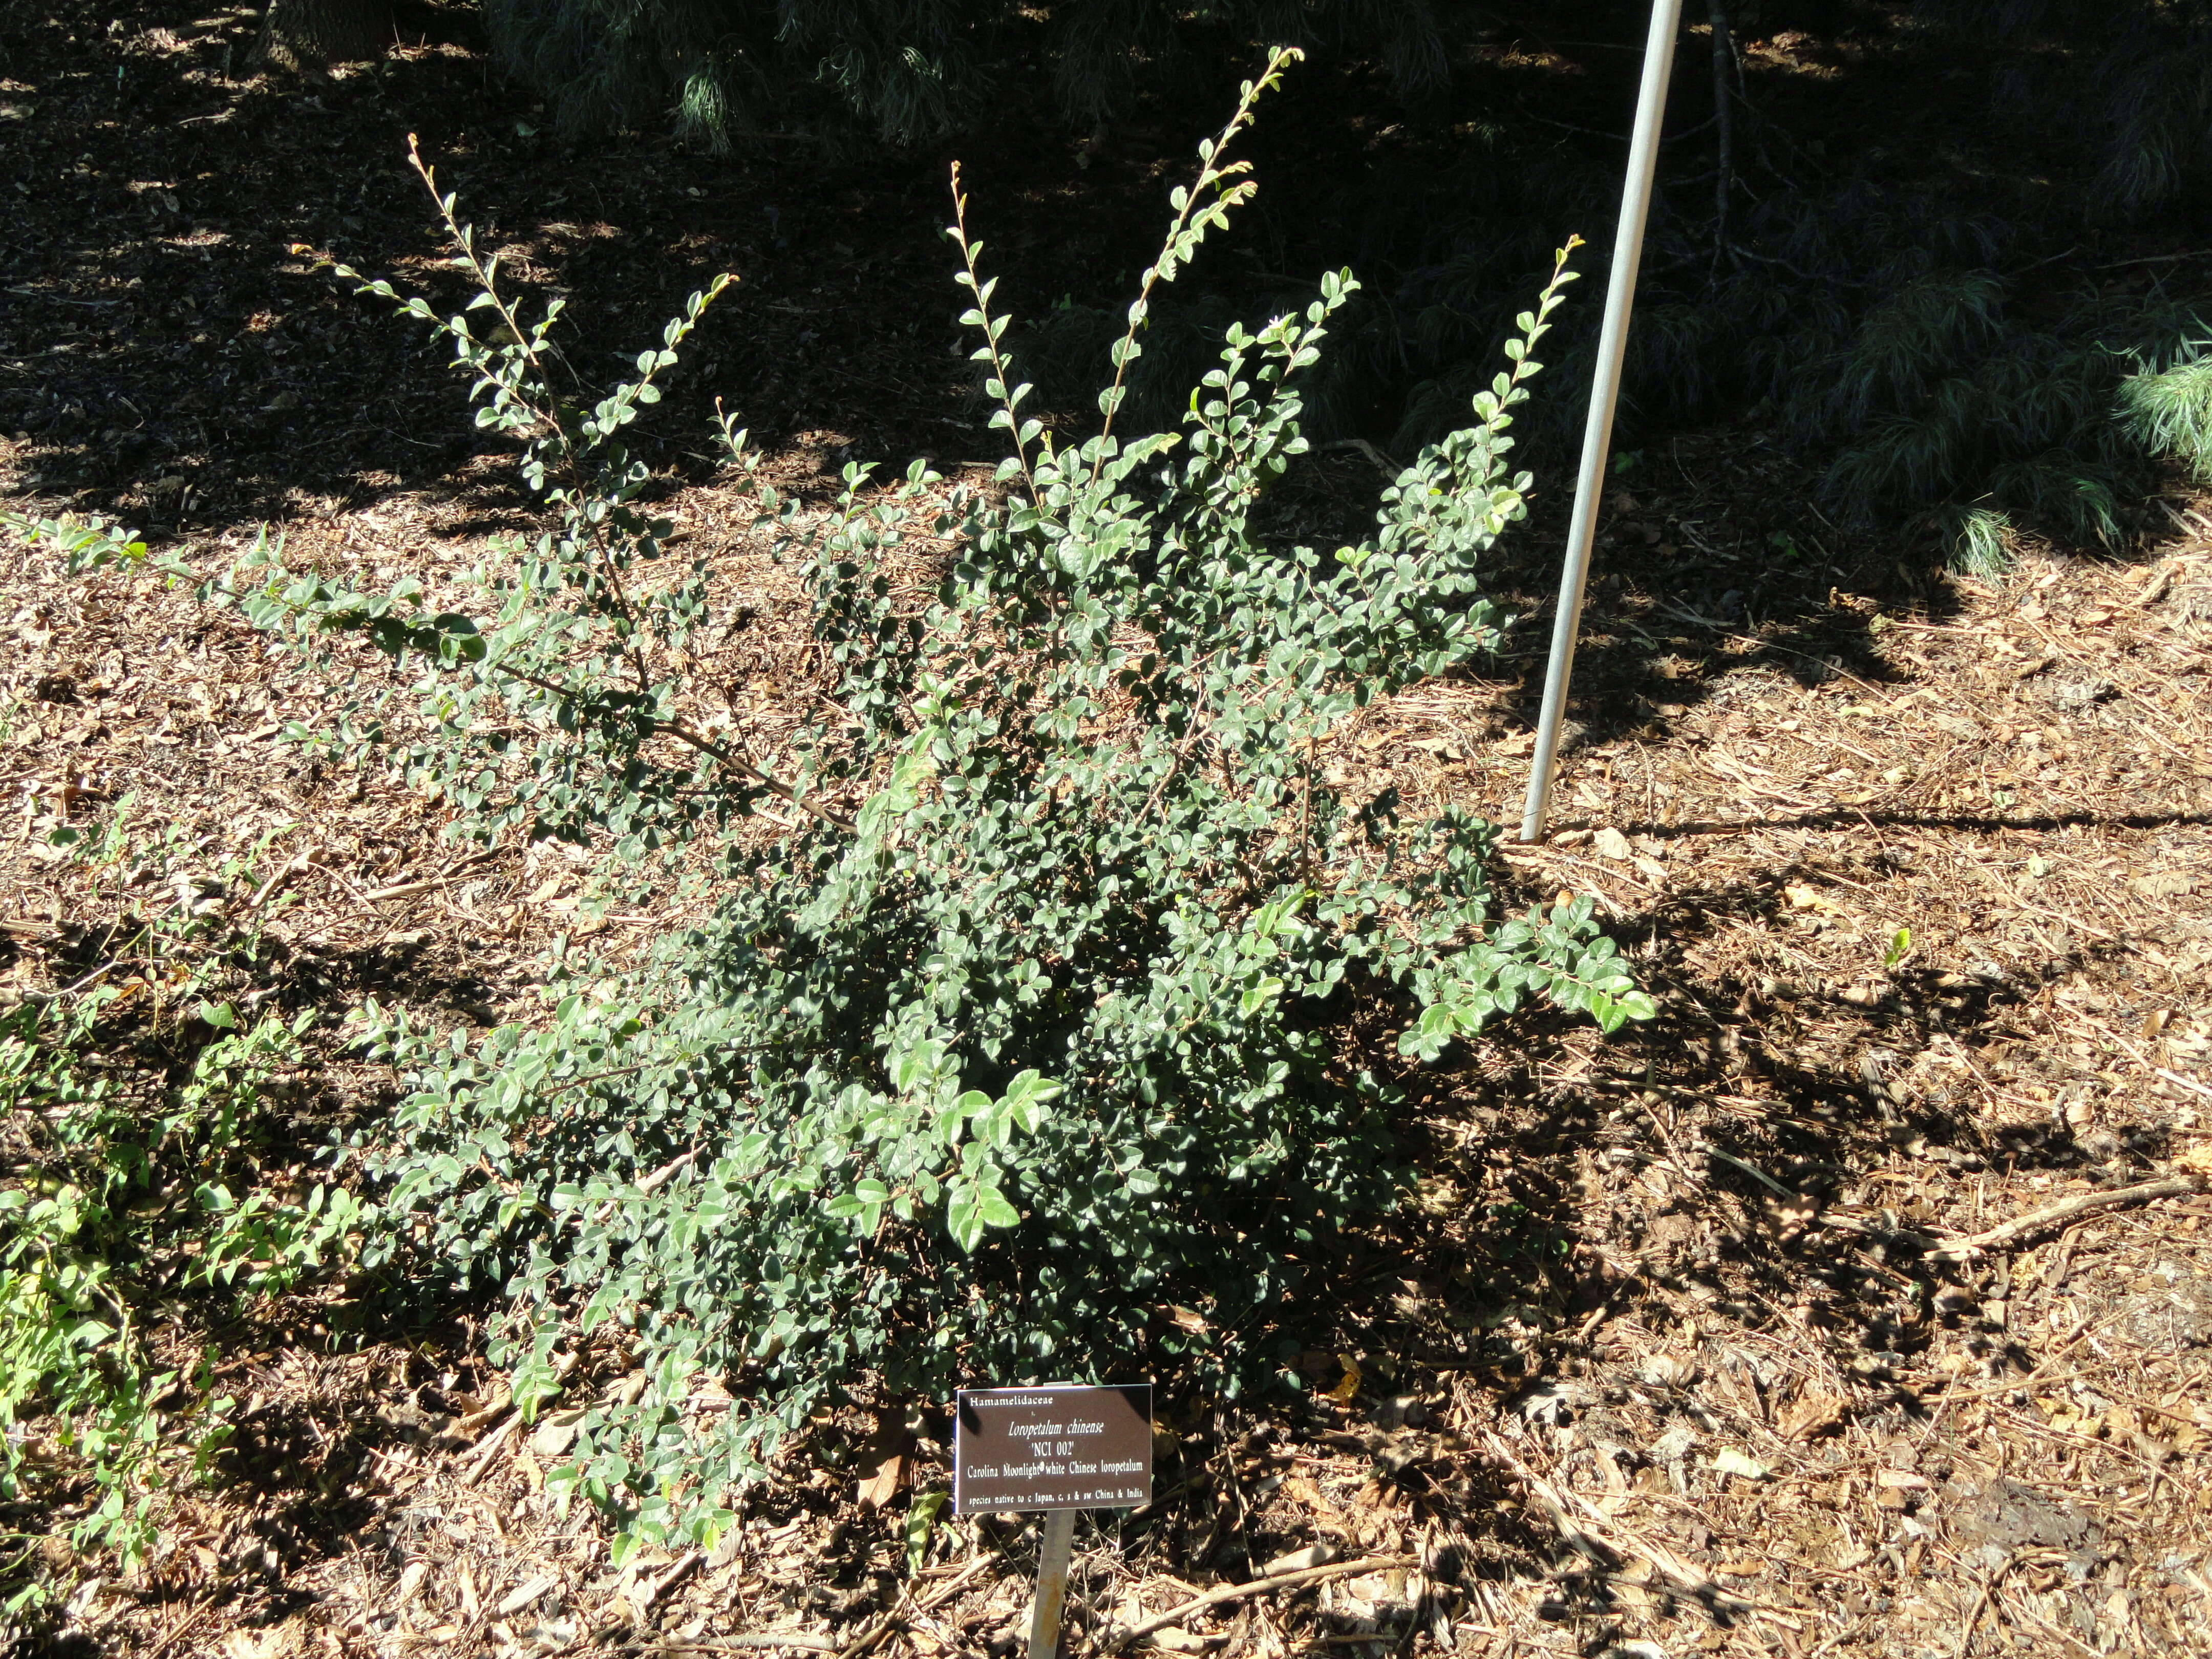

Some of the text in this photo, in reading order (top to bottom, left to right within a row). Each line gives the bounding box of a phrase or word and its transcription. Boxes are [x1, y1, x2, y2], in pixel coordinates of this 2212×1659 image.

[970, 1395, 1053, 1406] Hamamelidaceae
[1009, 1419, 1104, 1439] Loropetalum chinense
[968, 1465, 998, 1478] Carolina
[1046, 1463, 1065, 1475] white
[1069, 1462, 1097, 1474] Chinese
[1101, 1459, 1143, 1476] loropetalum
[969, 1495, 991, 1506] species
[995, 1493, 1014, 1503] native
[1018, 1494, 1024, 1502] to
[1035, 1492, 1054, 1504] Japan,
[1074, 1491, 1079, 1500] &
[1096, 1490, 1114, 1499] China
[1127, 1488, 1143, 1498] India
